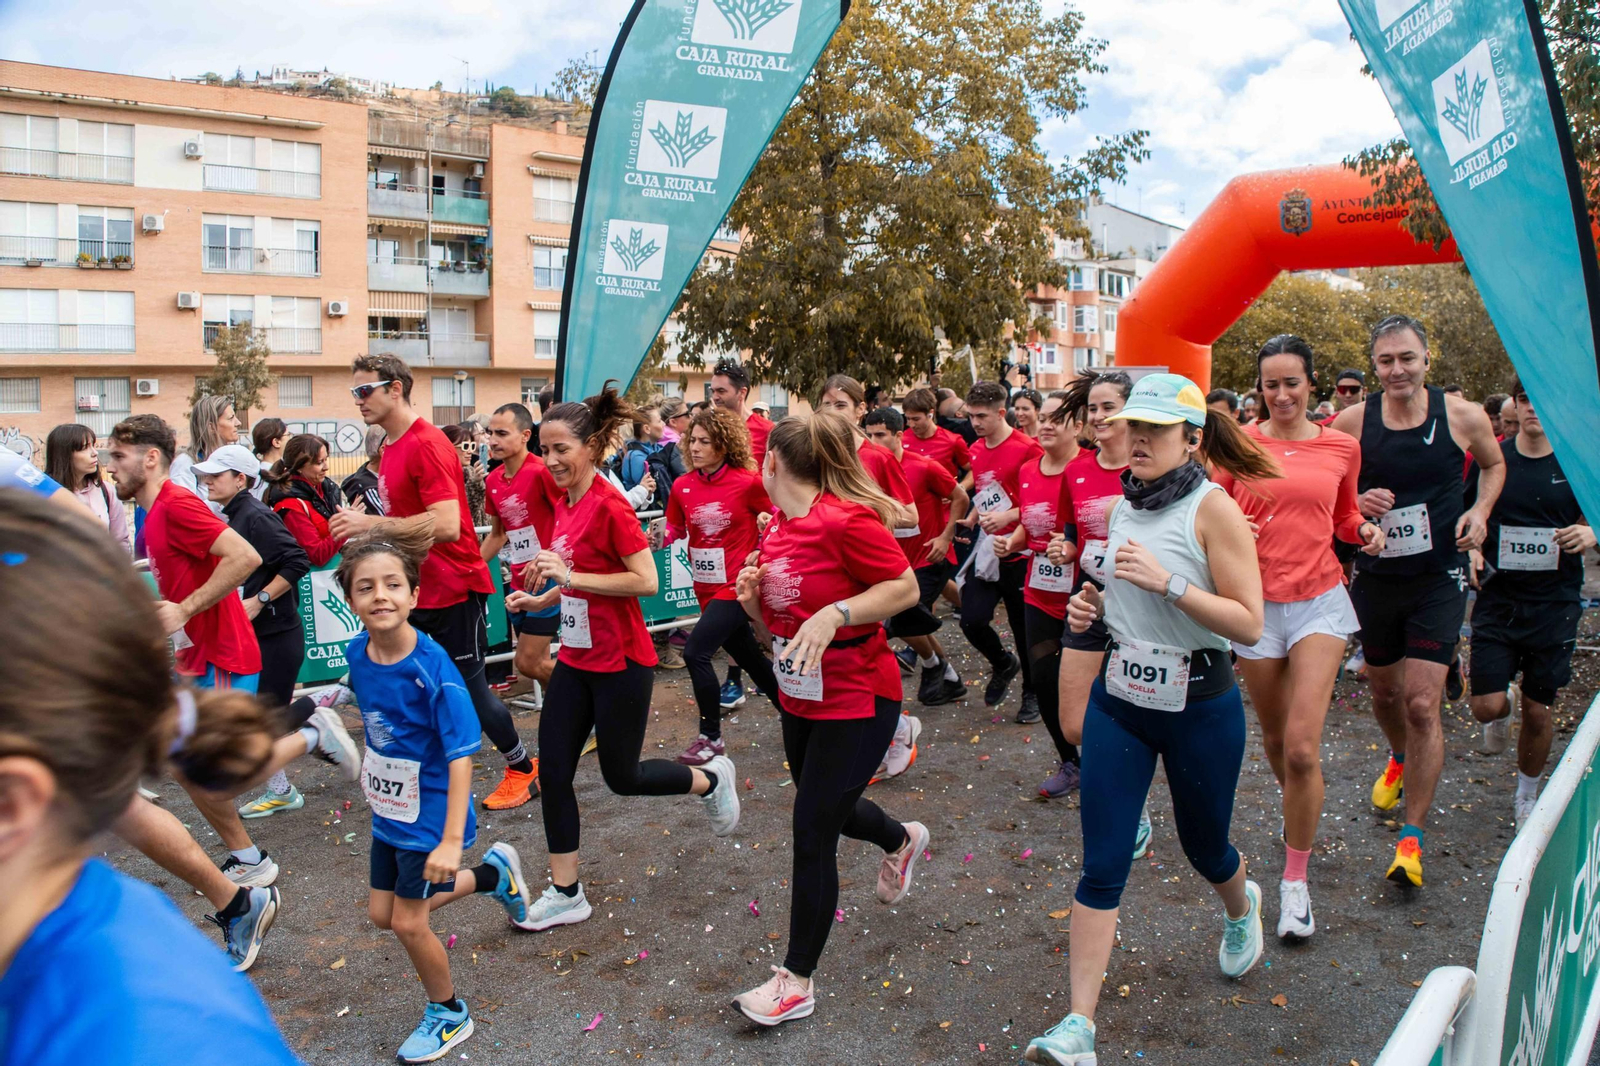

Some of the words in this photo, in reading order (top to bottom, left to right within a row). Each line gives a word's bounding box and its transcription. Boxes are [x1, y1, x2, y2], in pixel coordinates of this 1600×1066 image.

[675, 45, 720, 64] CAJA
[724, 50, 789, 73] RURAL
[697, 65, 763, 82] GRANADA
[625, 101, 644, 169] fundación
[624, 172, 660, 188] CAJA
[663, 176, 717, 194] RURAL
[641, 188, 695, 203] GRANADA
[596, 220, 609, 274] fundación
[595, 275, 619, 287] CAJA
[621, 278, 661, 292] RURAL
[604, 287, 645, 298] GRANADA
[981, 493, 1001, 511] 748
[1387, 524, 1415, 540] 419
[1509, 542, 1548, 555] 1380
[695, 560, 715, 571] 665
[1038, 563, 1063, 578] 698
[664, 590, 688, 602] CAJA
[307, 644, 343, 660] CAJA
[1122, 659, 1168, 685] 1091
[1127, 682, 1157, 694] NOELIA
[367, 772, 404, 797] 1037
